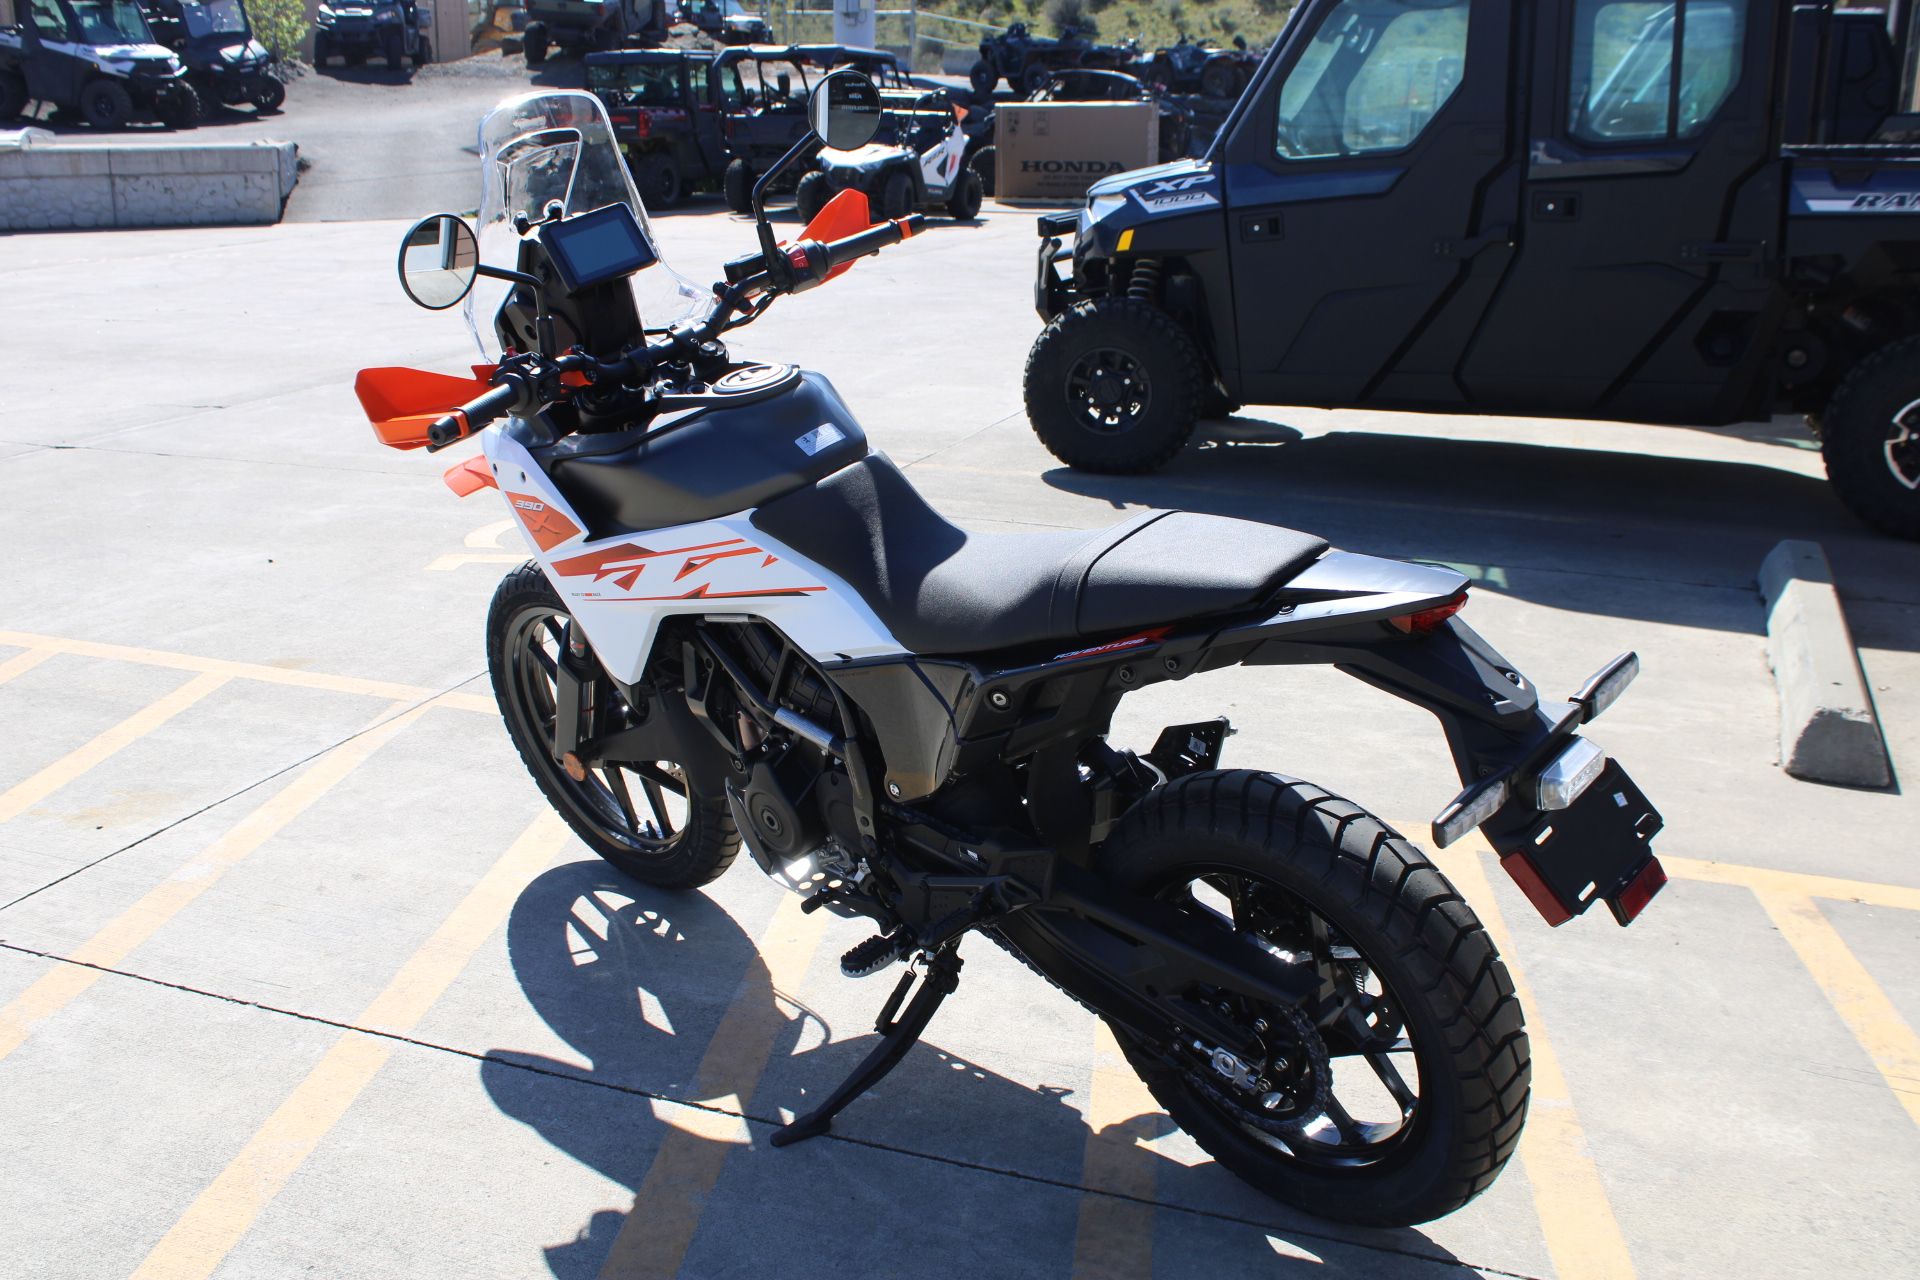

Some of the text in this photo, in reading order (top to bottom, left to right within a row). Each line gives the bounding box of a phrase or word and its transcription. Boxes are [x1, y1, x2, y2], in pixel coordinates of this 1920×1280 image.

[1020, 159, 1126, 174] HONDA
[1144, 174, 1216, 195] XP
[1153, 191, 1206, 205] 1000
[514, 500, 545, 512] 390
[1053, 637, 1148, 660] ADVENTURE
